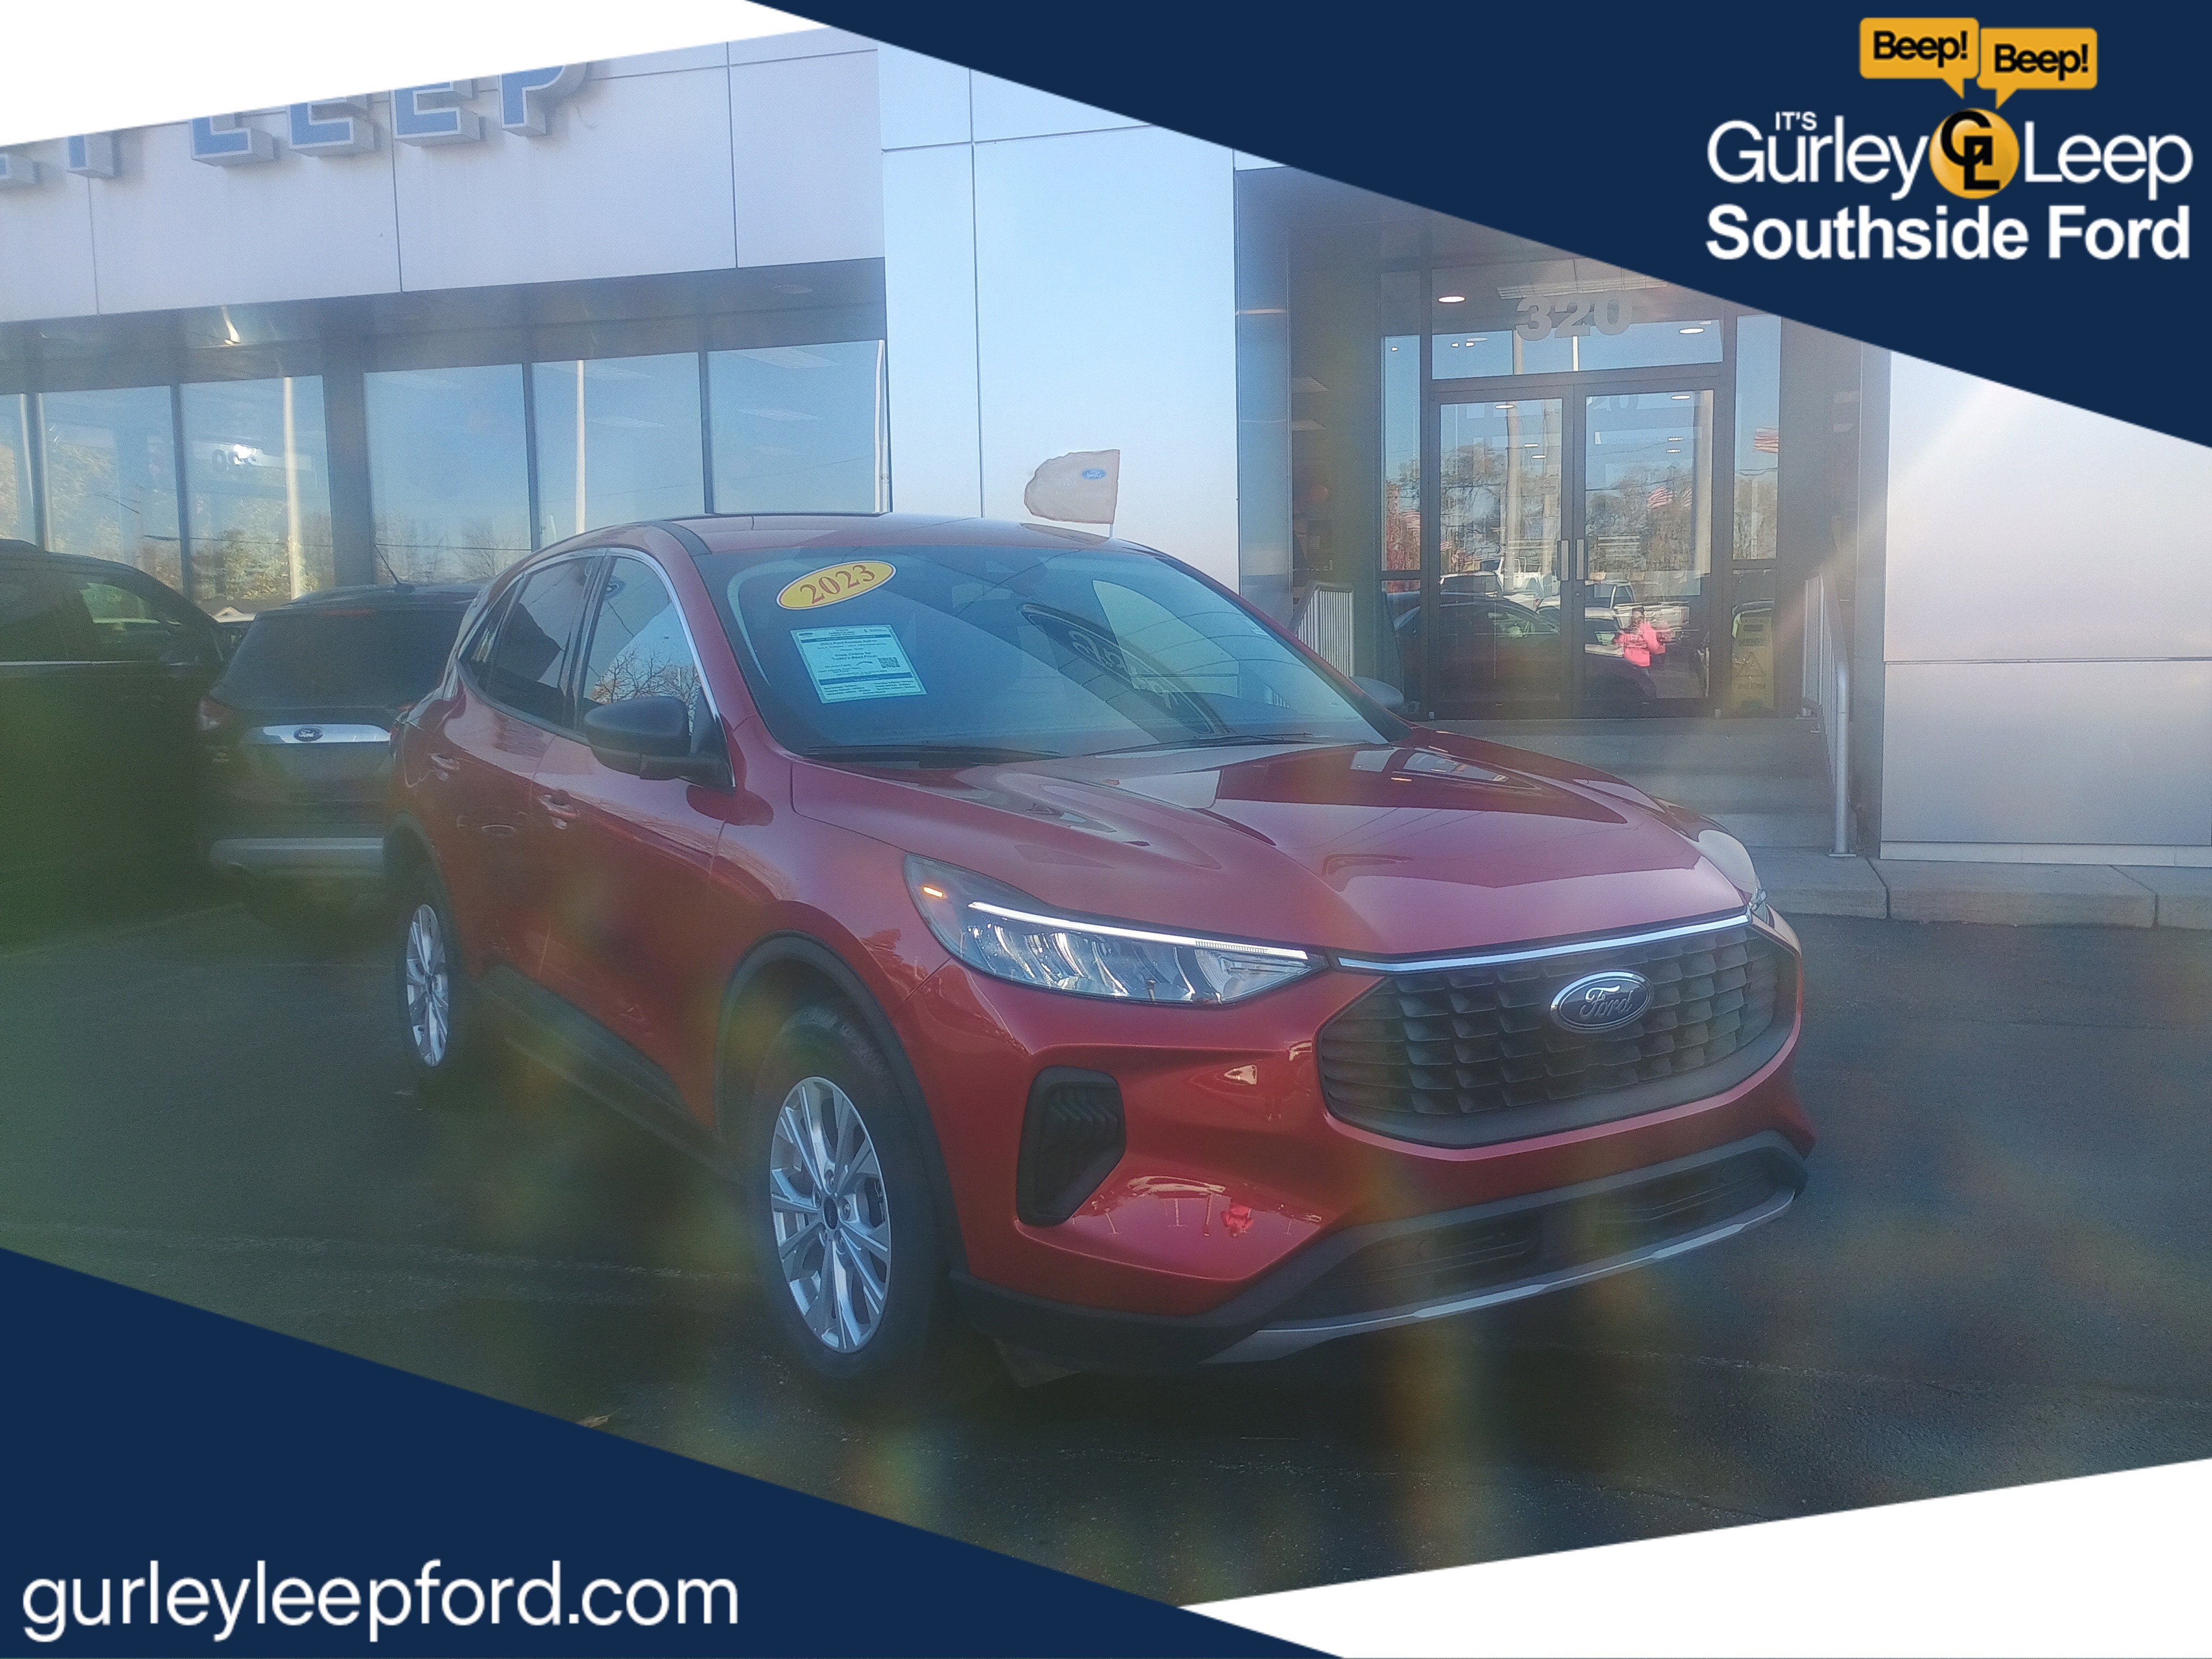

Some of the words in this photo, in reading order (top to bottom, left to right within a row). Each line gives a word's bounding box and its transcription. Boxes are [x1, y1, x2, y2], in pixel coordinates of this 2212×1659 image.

[1516, 292, 1633, 341] 320
[800, 564, 875, 604] 2023
[1579, 985, 1635, 1019] Ford
